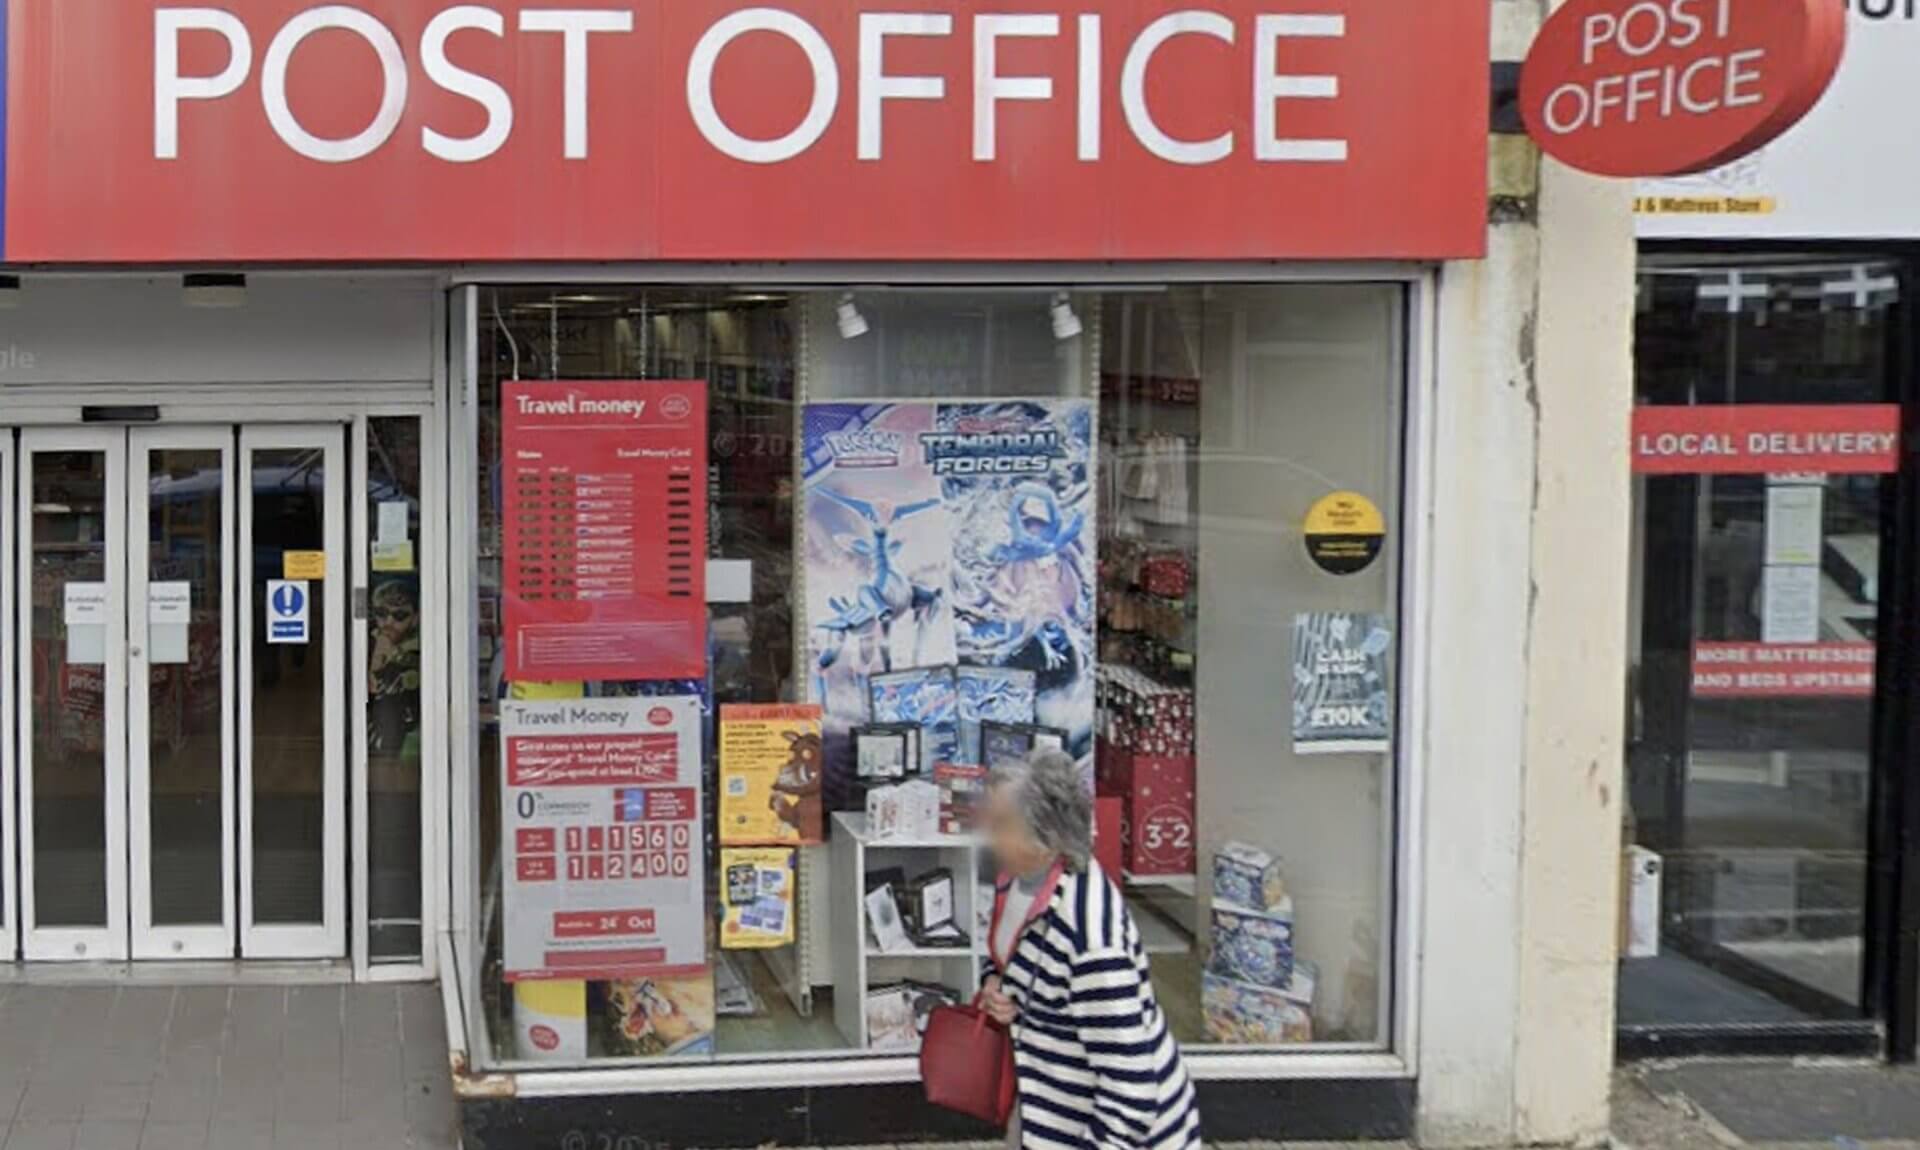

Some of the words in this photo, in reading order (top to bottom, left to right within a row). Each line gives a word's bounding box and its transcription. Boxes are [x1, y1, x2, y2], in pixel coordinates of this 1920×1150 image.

[1583, 0, 1730, 64] POST
[155, 5, 633, 163] POST
[686, 7, 1349, 164] OFFICE
[1543, 48, 1765, 134] OFFICE
[516, 394, 575, 415] Travel
[579, 399, 646, 419] money
[1640, 433, 1738, 455] LOCAL
[1748, 431, 1896, 454] DELIVERY
[936, 457, 1050, 474] FORCES
[515, 707, 567, 725] Travel
[570, 706, 630, 728] Money
[628, 915, 653, 929] Oct
